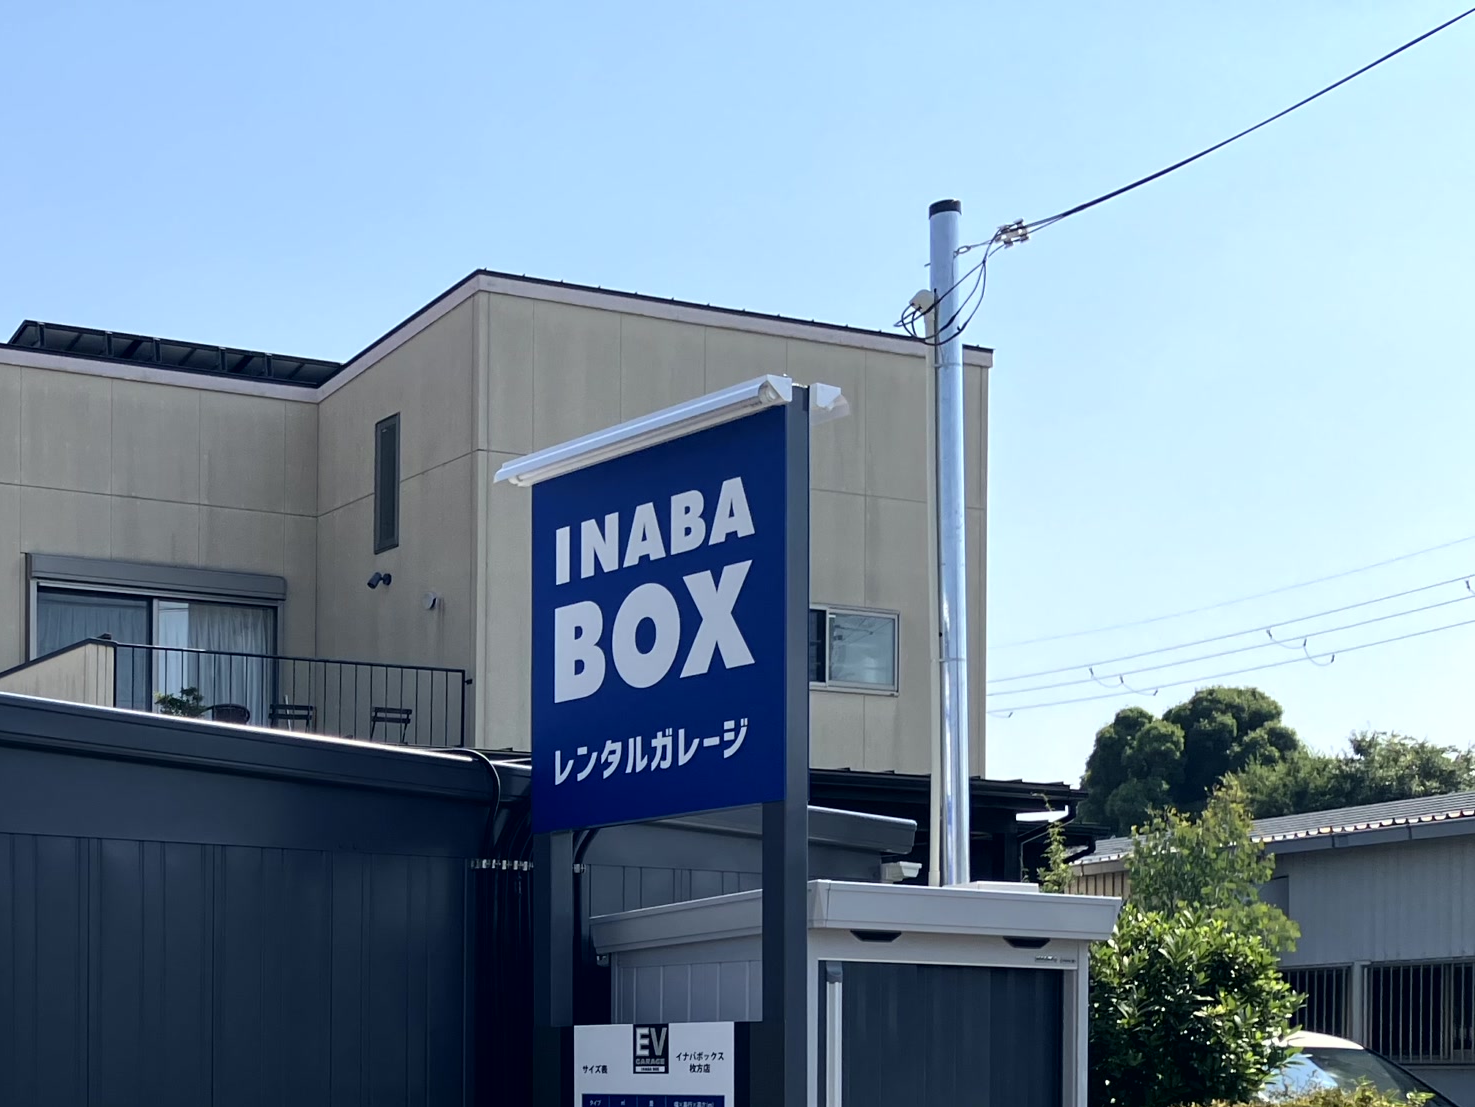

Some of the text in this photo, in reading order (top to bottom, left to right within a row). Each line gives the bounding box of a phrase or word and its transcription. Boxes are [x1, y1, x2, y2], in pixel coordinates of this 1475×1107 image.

[555, 476, 755, 586] INABA
[554, 560, 755, 703] BOX
[554, 717, 749, 786] レンタルガレージ
[636, 1027, 667, 1057] EV
[676, 1052, 724, 1062] イナバボックス
[582, 1065, 608, 1074] サイズ表
[689, 1063, 711, 1073] 枚方店
